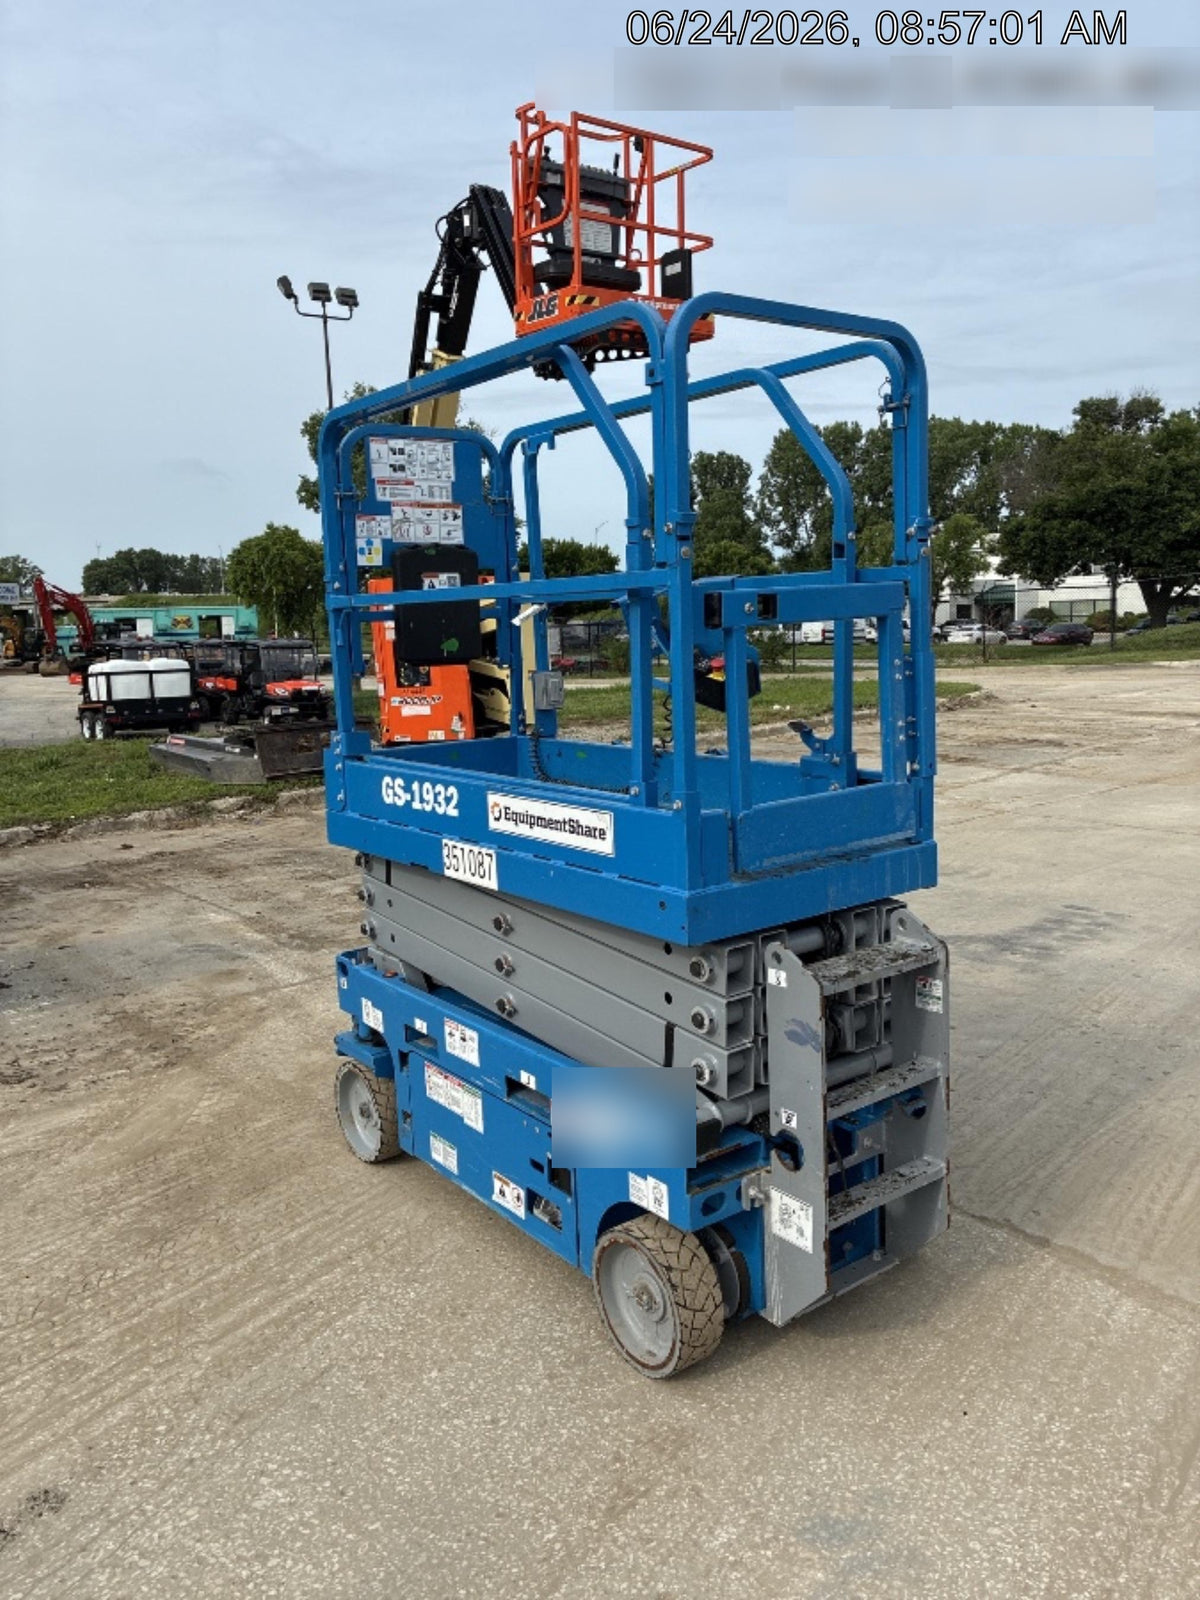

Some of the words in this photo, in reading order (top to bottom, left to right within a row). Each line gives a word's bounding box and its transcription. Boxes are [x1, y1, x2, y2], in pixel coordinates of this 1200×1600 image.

[527, 294, 559, 323] JLG
[382, 775, 459, 817] GS-1932
[504, 806, 607, 841] EquipmentShare
[444, 842, 493, 881] 351087
